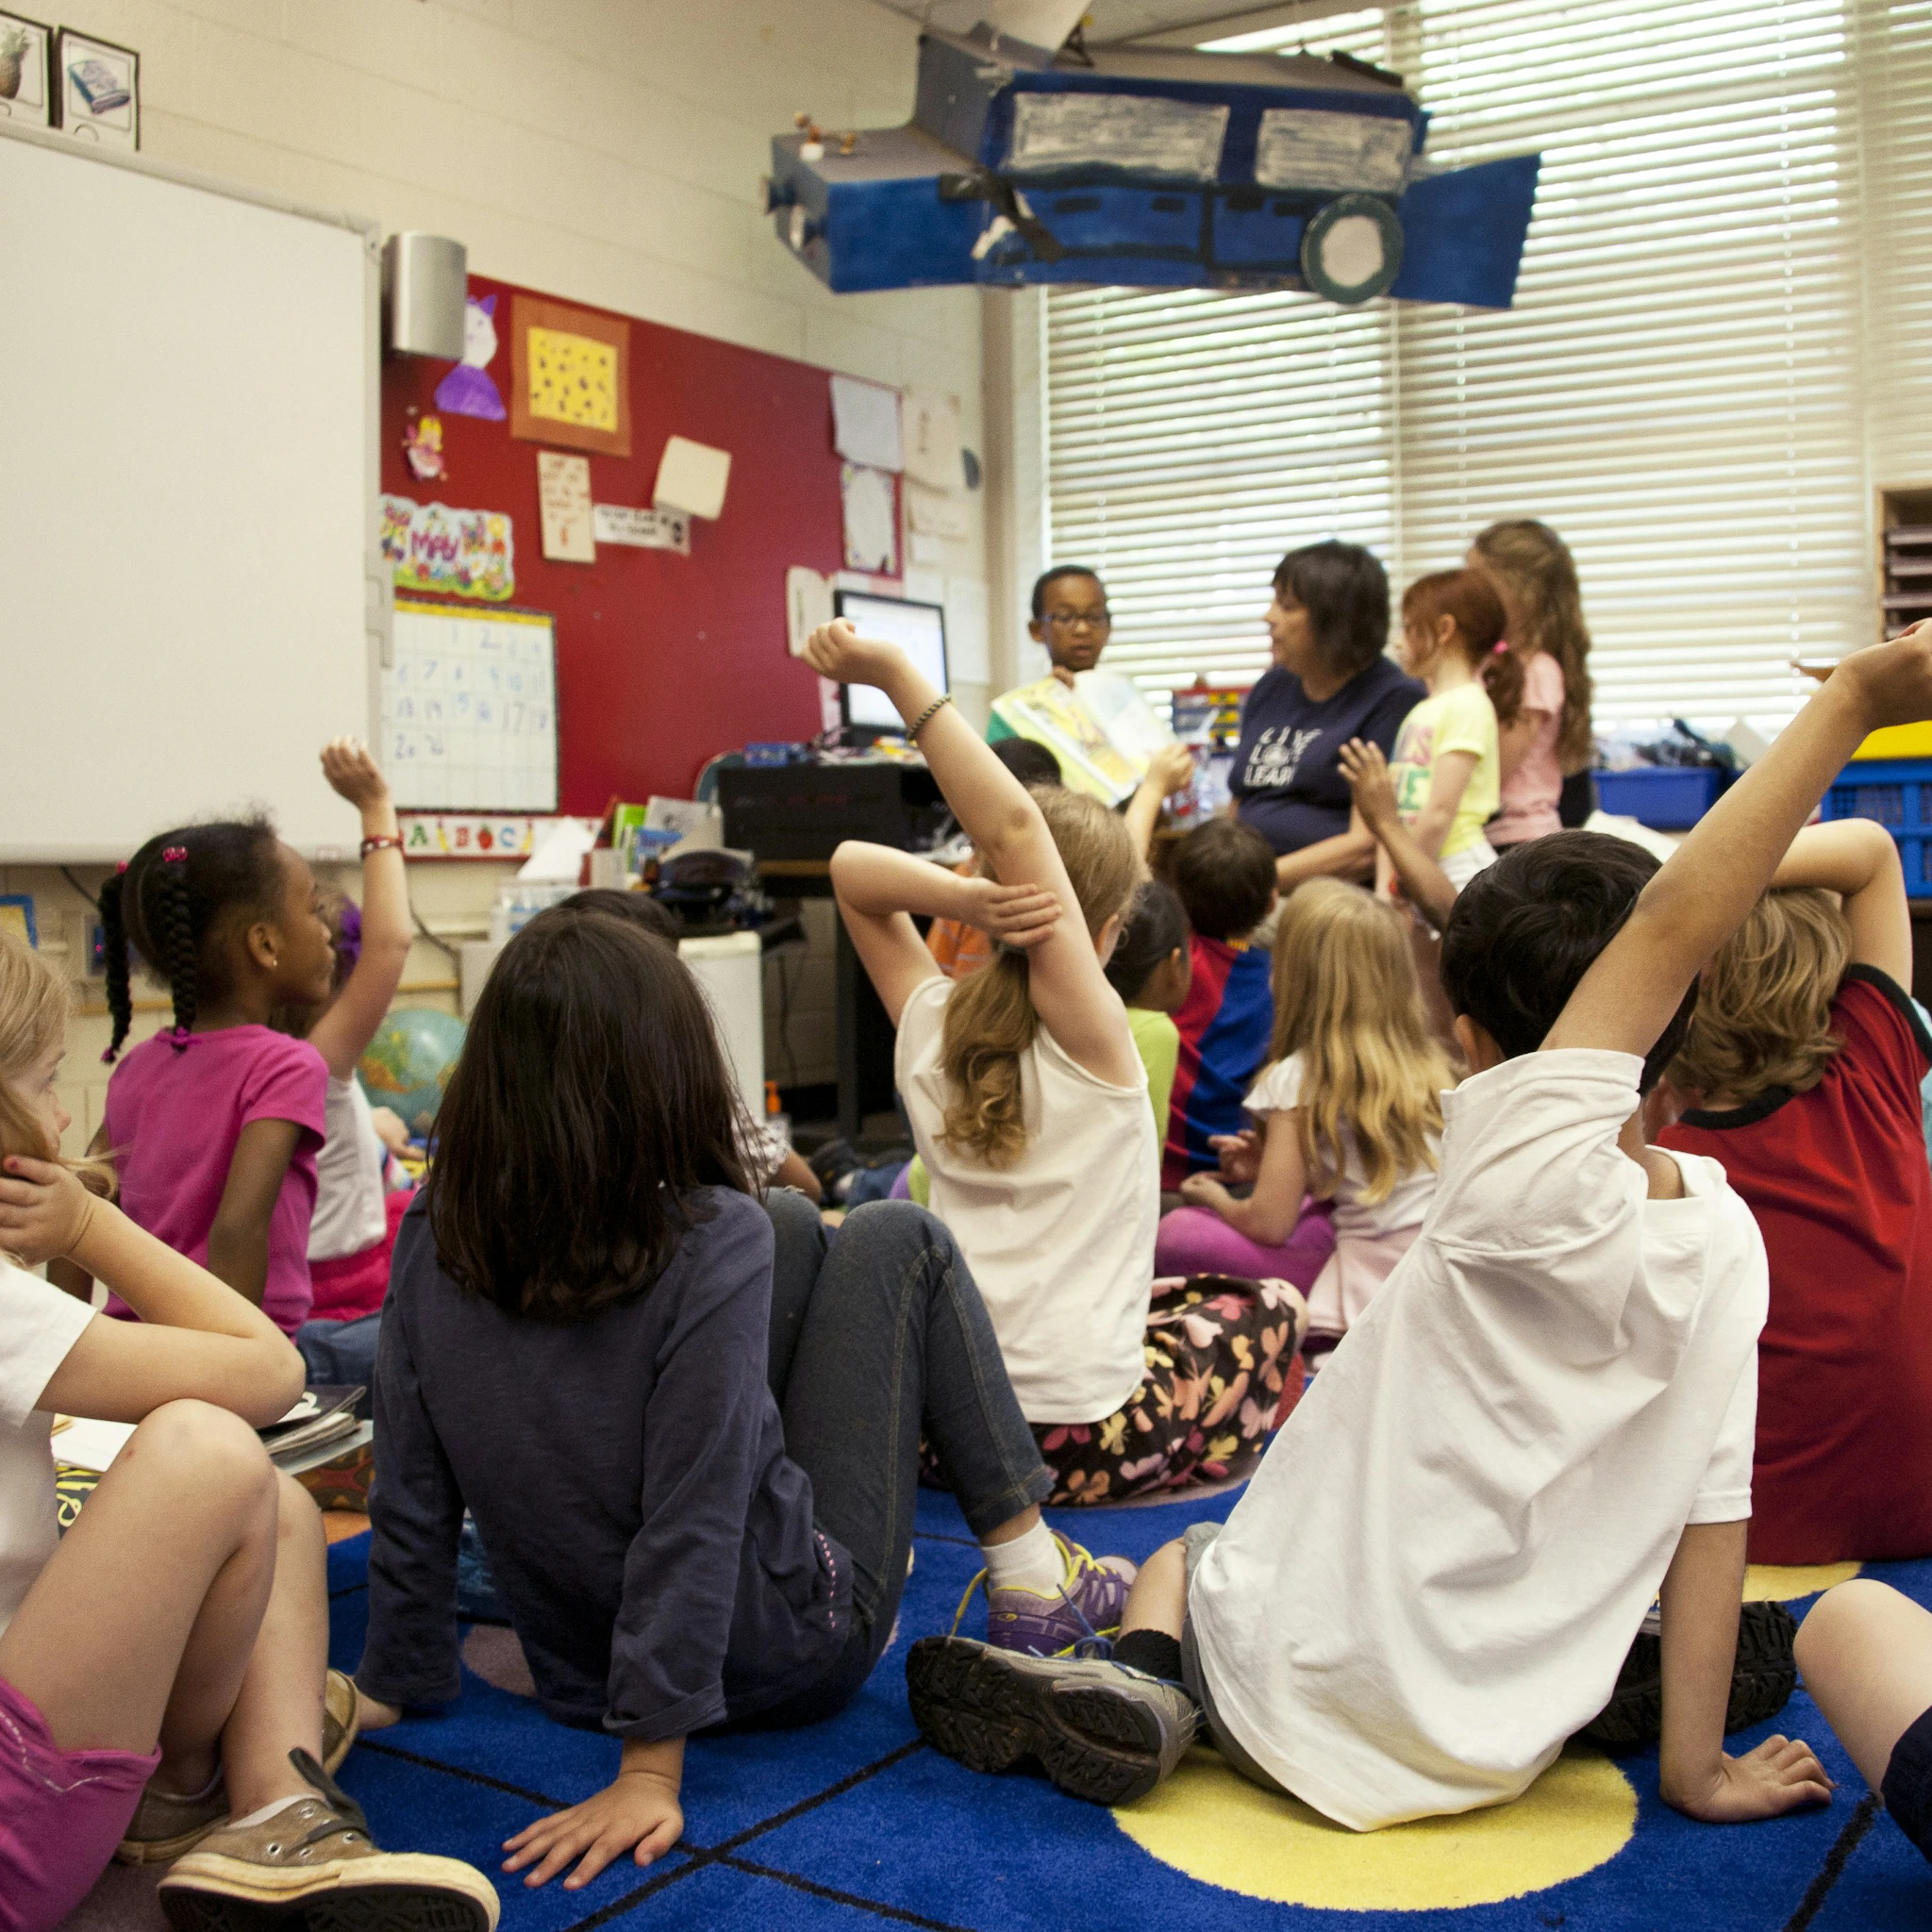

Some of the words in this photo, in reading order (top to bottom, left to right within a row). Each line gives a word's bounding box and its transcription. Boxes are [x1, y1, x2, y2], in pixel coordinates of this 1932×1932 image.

[479, 625, 502, 649] 2
[424, 660, 437, 680] 7
[502, 700, 525, 734] 17
[409, 824, 428, 846] A
[456, 826, 470, 847] B
[500, 826, 516, 847] C
